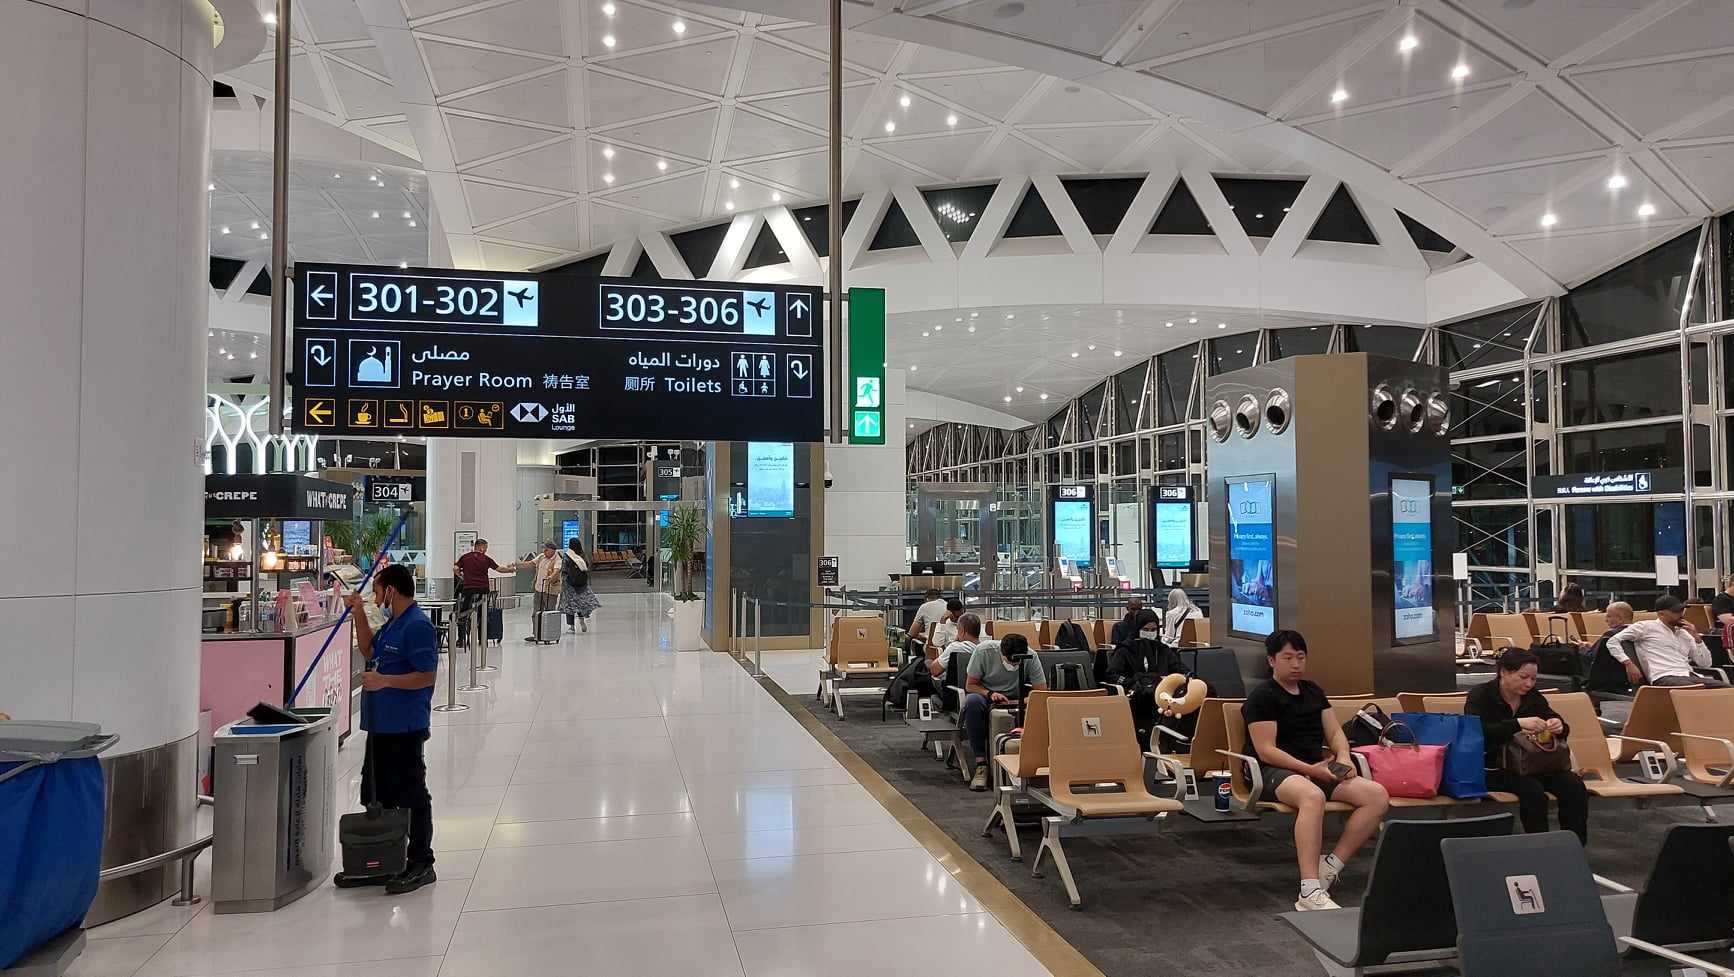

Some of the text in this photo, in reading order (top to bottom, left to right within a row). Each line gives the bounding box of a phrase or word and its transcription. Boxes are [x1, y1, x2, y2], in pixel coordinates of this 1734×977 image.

[357, 282, 499, 316] 301-302
[605, 293, 739, 325] 303-306
[411, 345, 470, 363] مصلى
[628, 351, 721, 370] دورات المياه
[412, 371, 533, 390] Prayer Room
[542, 373, 590, 391] 祷告室
[664, 377, 722, 394] Toilets
[551, 402, 576, 414] الأول
[551, 413, 576, 424] SAB
[551, 423, 576, 432] Lounge
[658, 468, 673, 476] 305
[215, 491, 258, 501] CREPE
[306, 490, 326, 508] WHAT
[328, 492, 347, 510] CREPE
[374, 485, 398, 498] 304
[1061, 488, 1077, 497] 306
[1161, 489, 1178, 497] 306
[322, 649, 343, 673] WHAT
